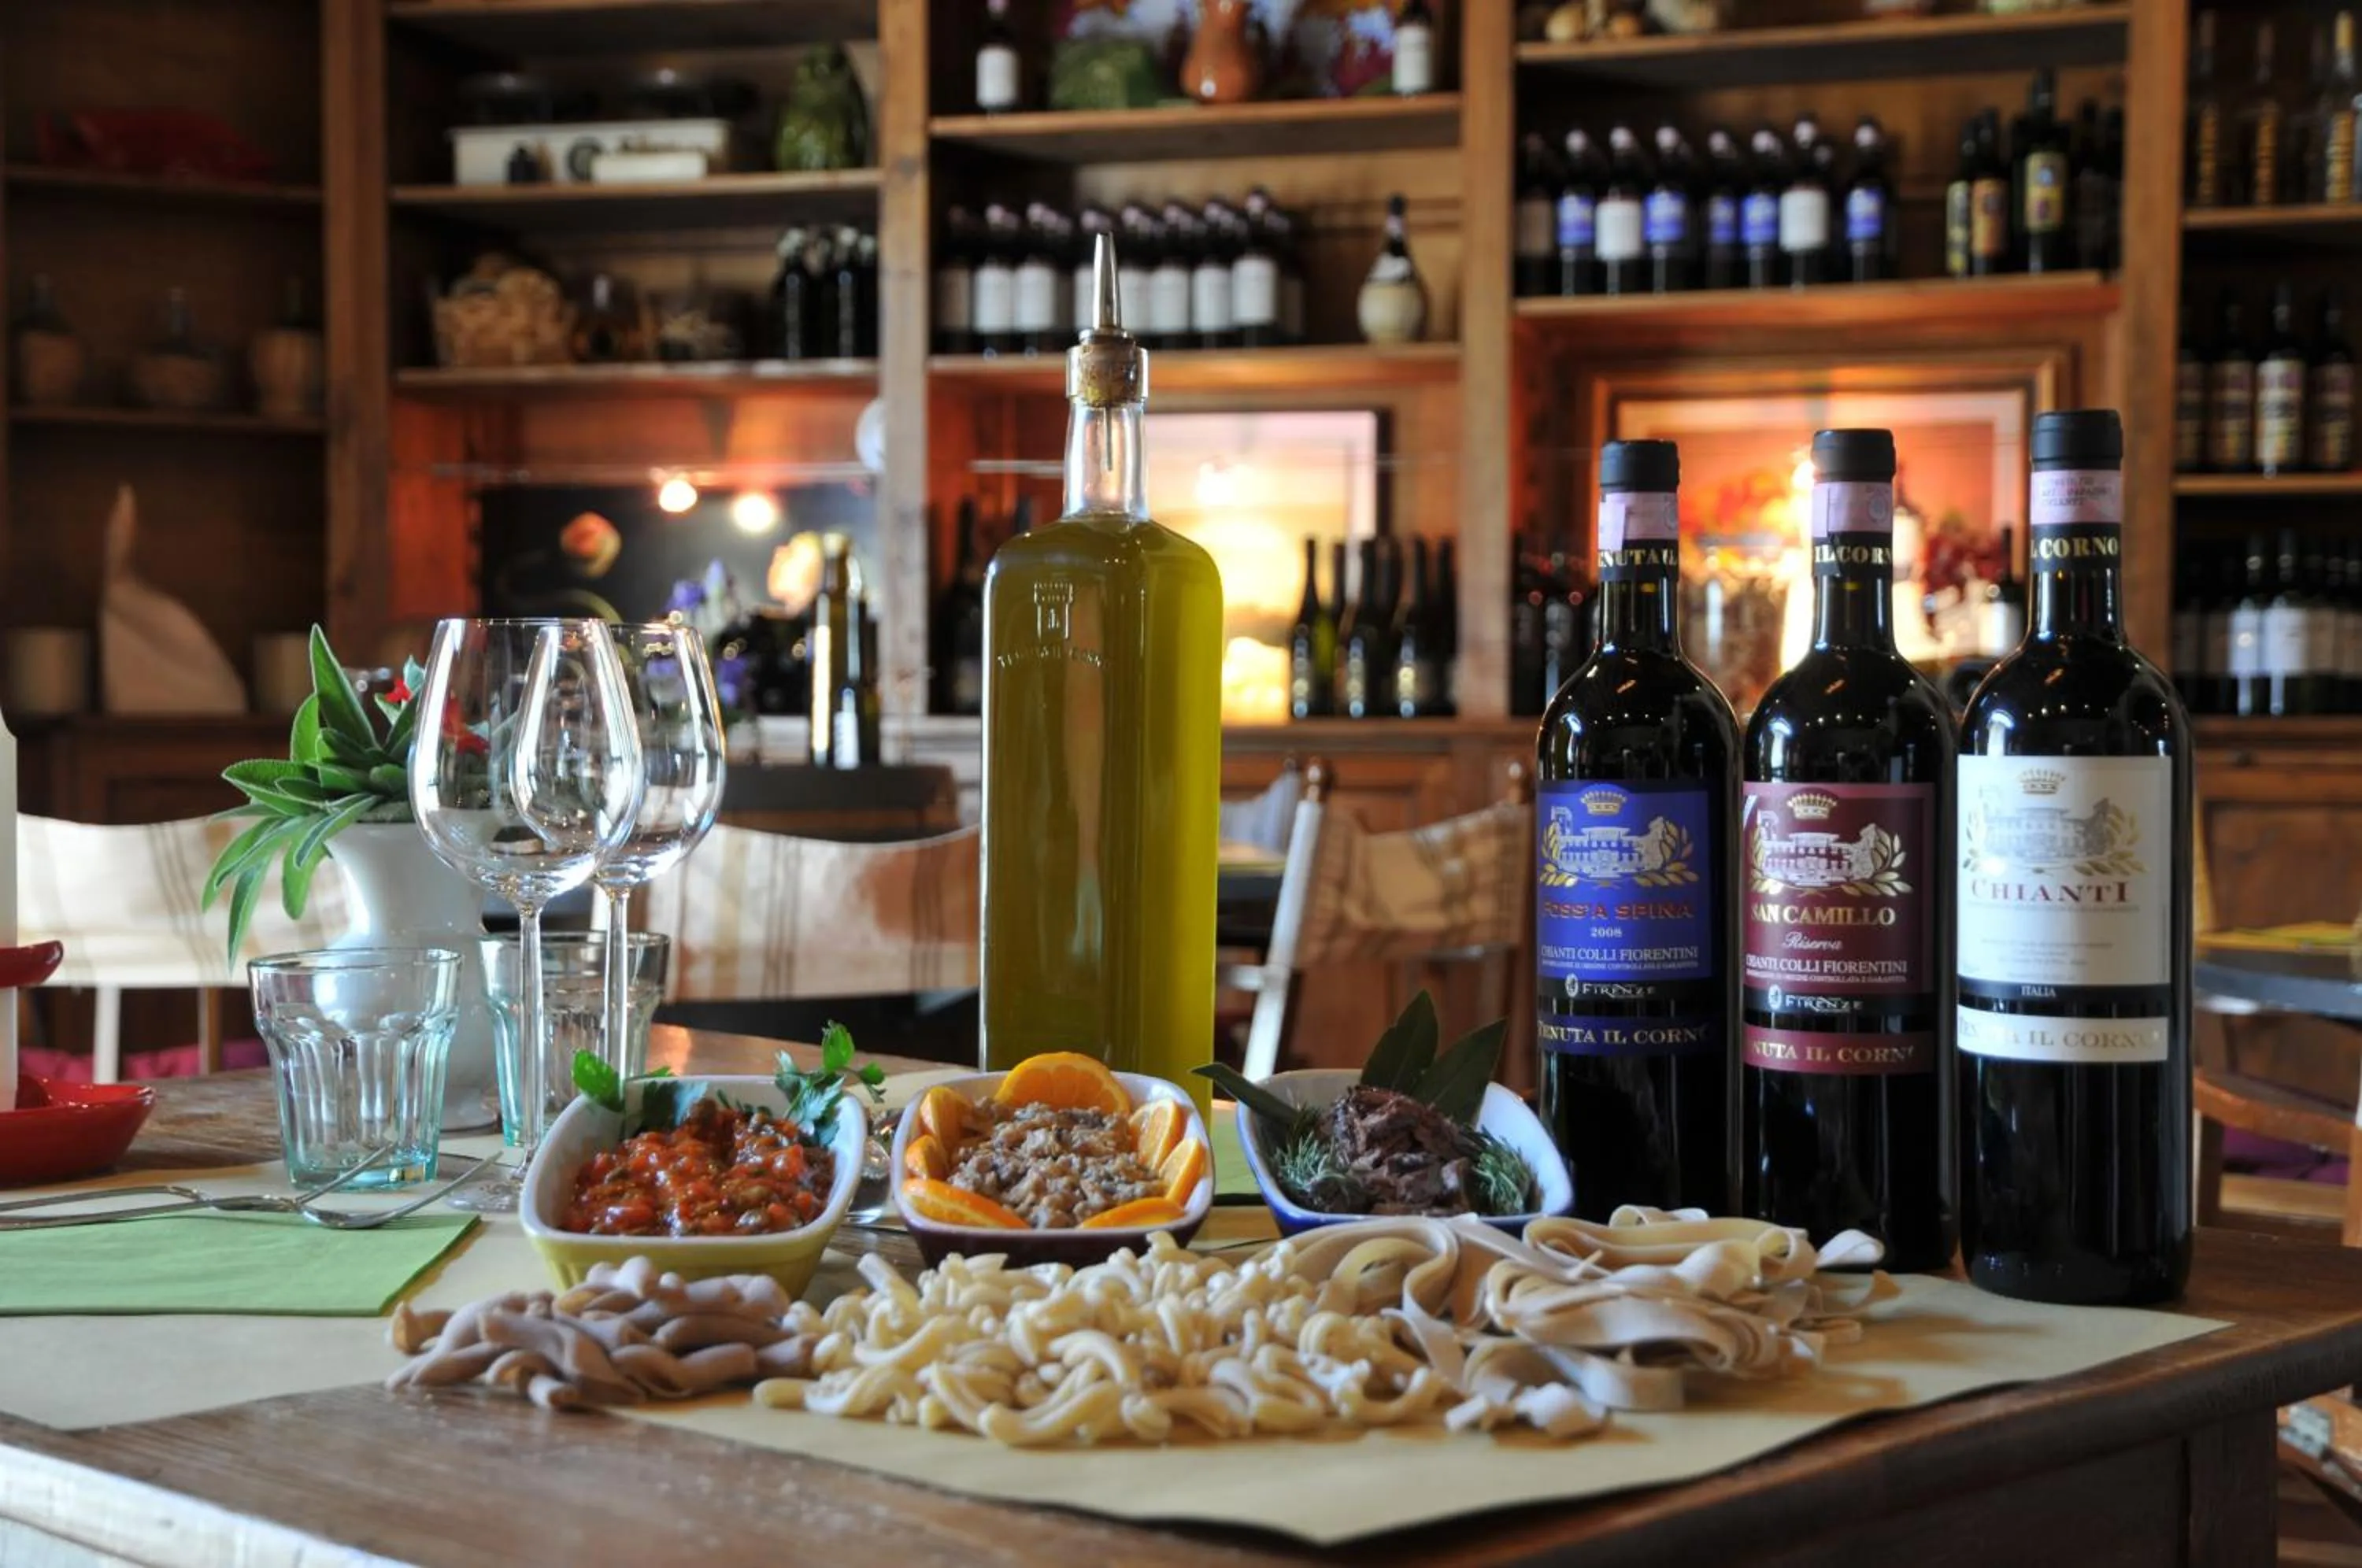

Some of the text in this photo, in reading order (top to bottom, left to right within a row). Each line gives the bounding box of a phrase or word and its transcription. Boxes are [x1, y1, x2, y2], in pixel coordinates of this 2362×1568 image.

[2039, 537, 2118, 560] CORNO
[1971, 878, 2129, 903] CHIANTI
[1615, 902, 1695, 919] SPINA
[1782, 904, 1897, 926] CAMILLO
[1590, 926, 1623, 938] 2008
[1783, 931, 1843, 951] Riserva
[1577, 947, 1616, 961] COLLI
[1620, 945, 1698, 961] FIORENTINI
[1779, 958, 1820, 973] COLLI
[1823, 959, 1908, 974] FIORENTINI
[2021, 985, 2057, 998] ITALIA
[1785, 994, 1864, 1013] FIRENZE
[1602, 1030, 1627, 1045] IL
[2029, 1030, 2054, 1046] IL
[1805, 1046, 1831, 1062] IL
